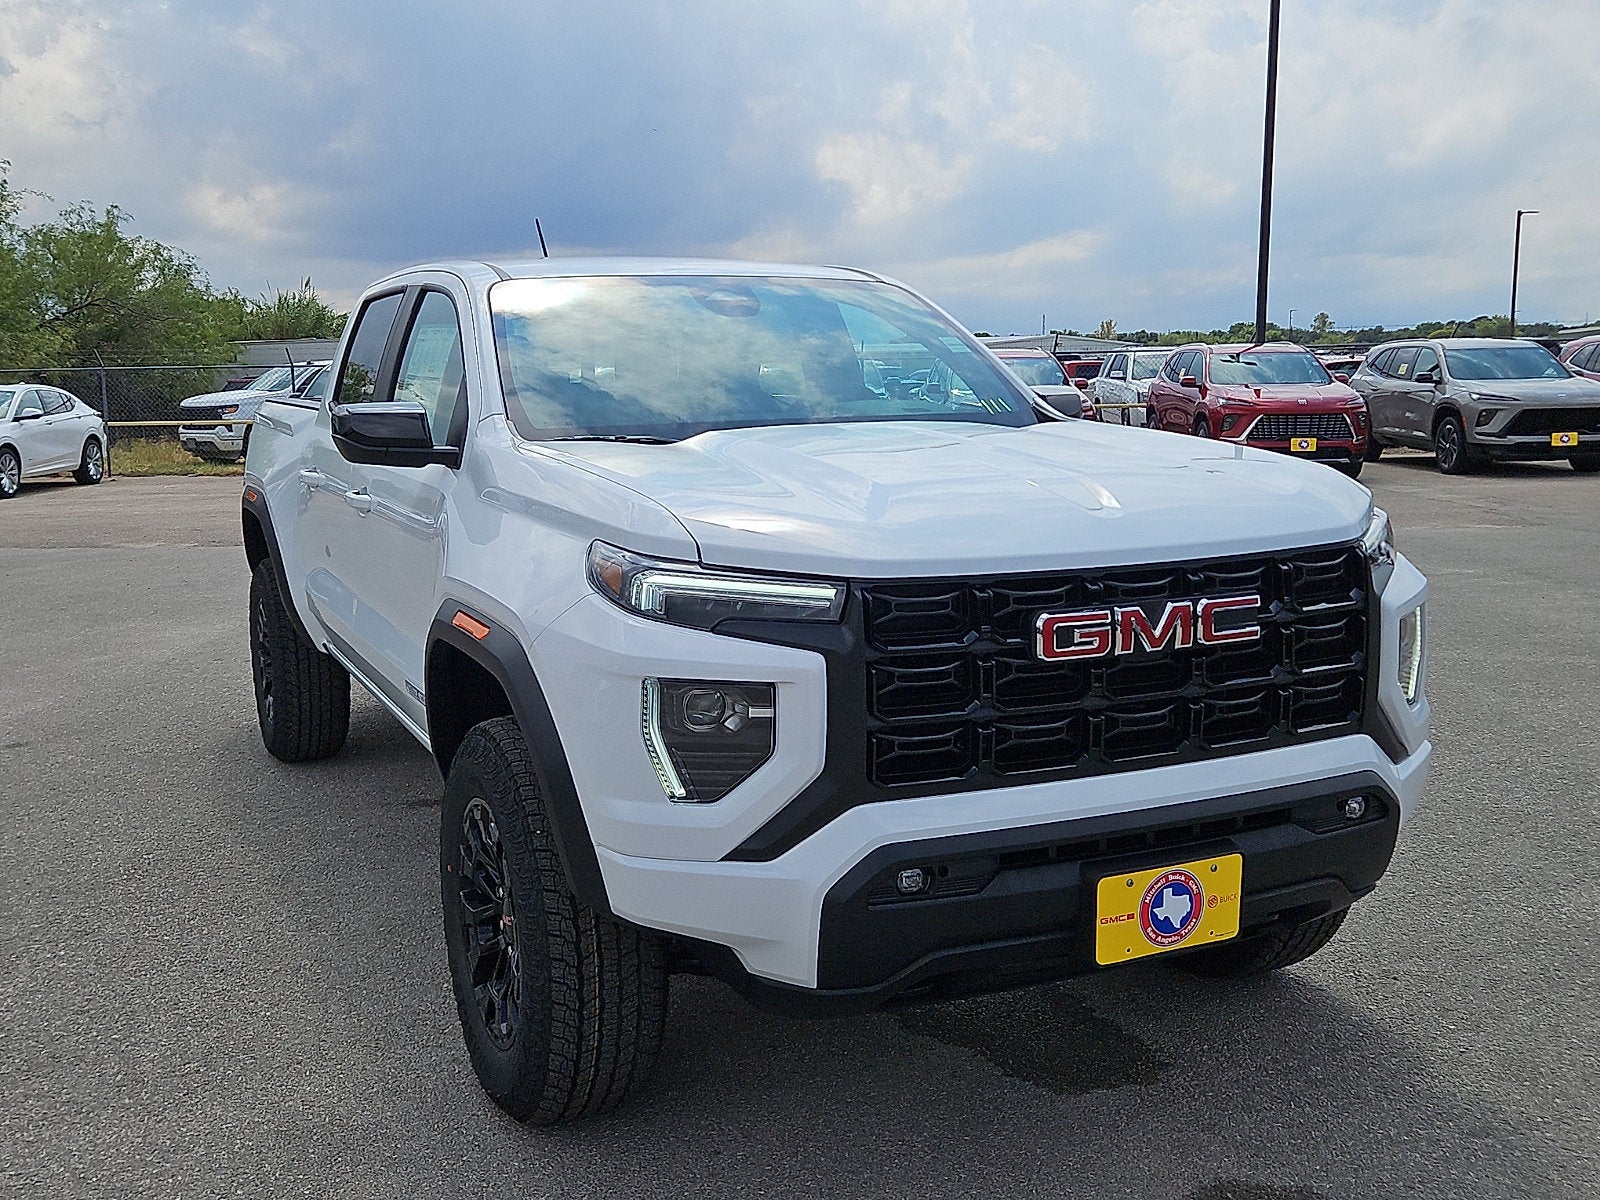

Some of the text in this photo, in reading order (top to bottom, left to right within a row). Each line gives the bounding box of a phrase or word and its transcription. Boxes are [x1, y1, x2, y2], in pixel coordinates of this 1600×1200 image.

[1036, 595, 1260, 661] GMC
[1219, 893, 1237, 903] BUICK
[1100, 914, 1127, 925] GMC
